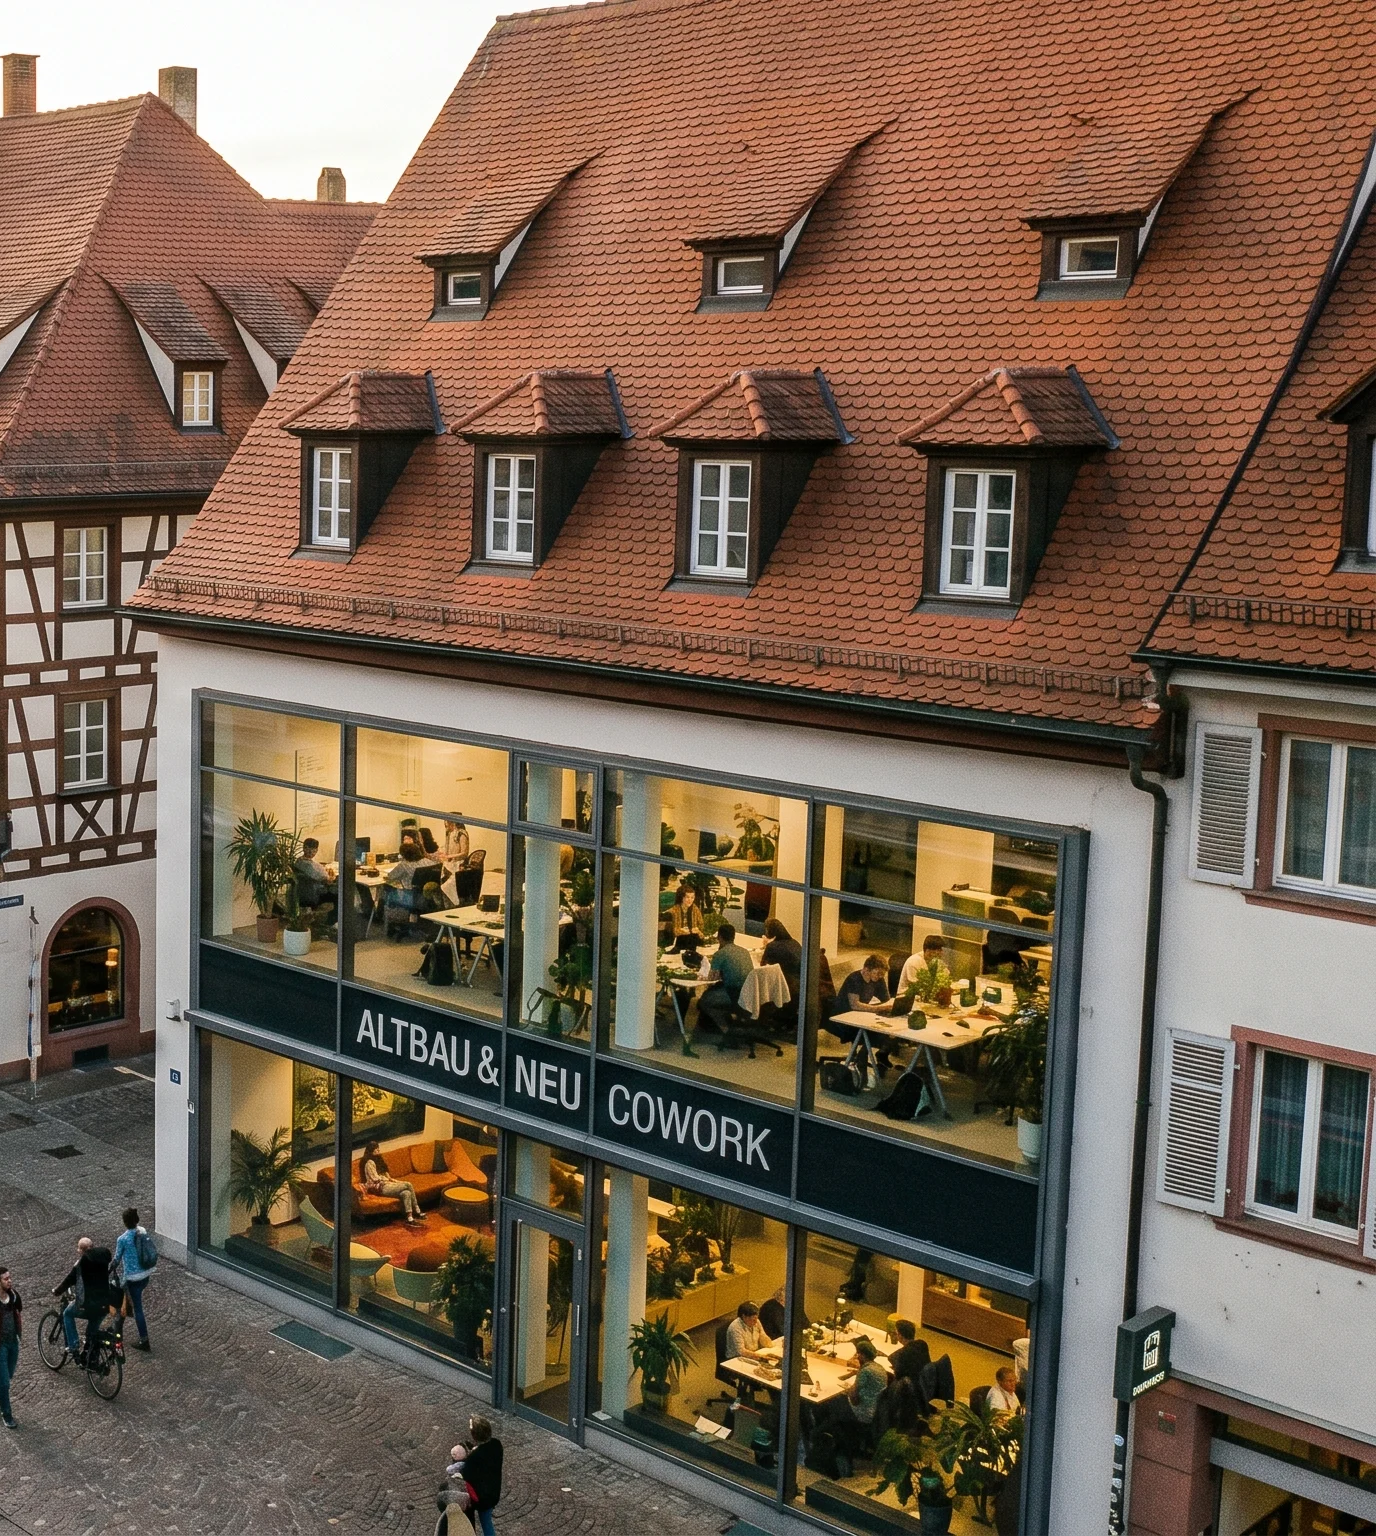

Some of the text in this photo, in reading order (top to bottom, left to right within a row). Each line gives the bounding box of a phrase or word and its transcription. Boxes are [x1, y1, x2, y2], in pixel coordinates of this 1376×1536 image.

[356, 1008, 772, 1172] ALTBAU & NEU COWORK
